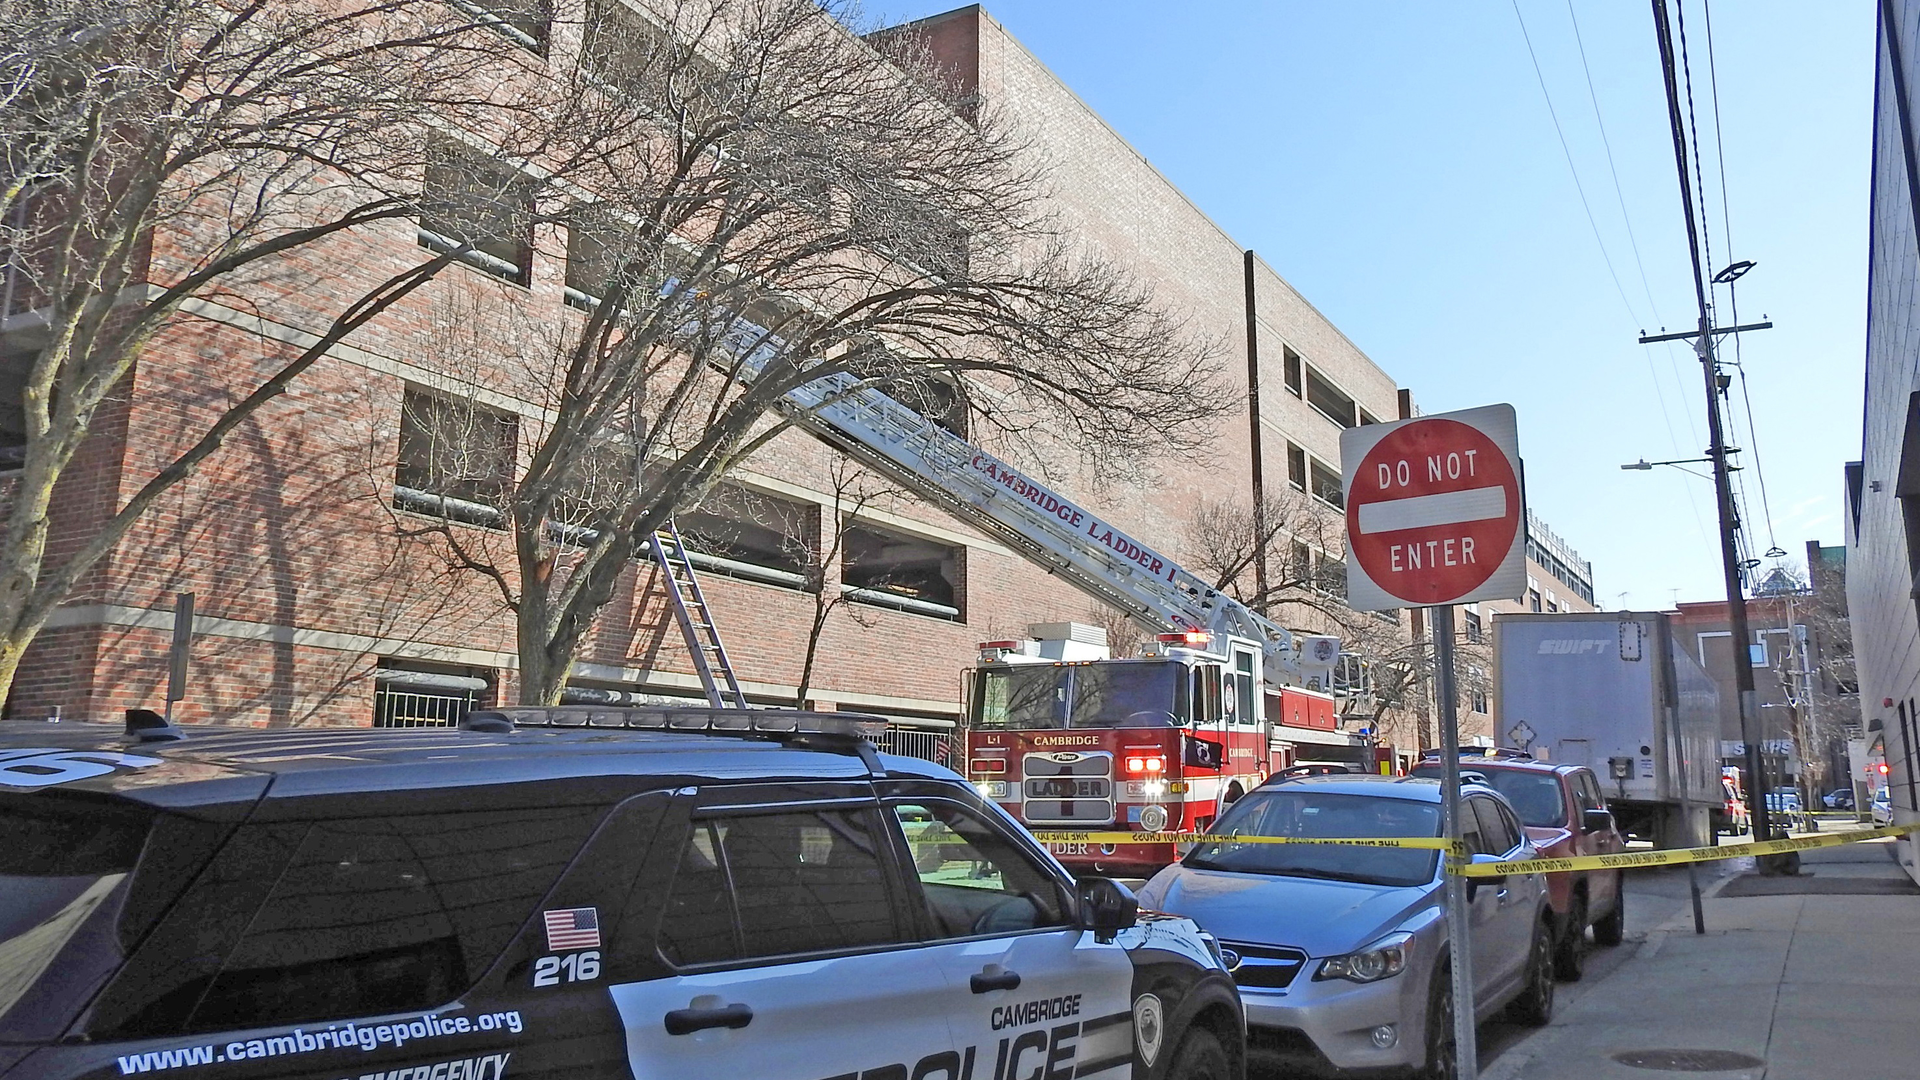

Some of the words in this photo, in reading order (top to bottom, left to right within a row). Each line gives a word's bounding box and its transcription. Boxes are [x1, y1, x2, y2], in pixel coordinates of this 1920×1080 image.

[1378, 460, 1410, 490] DO
[1428, 450, 1477, 482] NOT
[972, 455, 1083, 528] CAMBRIDGE
[1087, 521, 1164, 575] LADDER
[1391, 537, 1476, 572] ENTER
[1537, 639, 1612, 655] SWIFT
[1034, 735, 1100, 746] CAMBRIDGE
[1032, 781, 1102, 796] LADDER
[533, 950, 601, 988] 216
[991, 993, 1082, 1031] CAMBRIDGE
[117, 1009, 523, 1075] www.cambridgepolice.org
